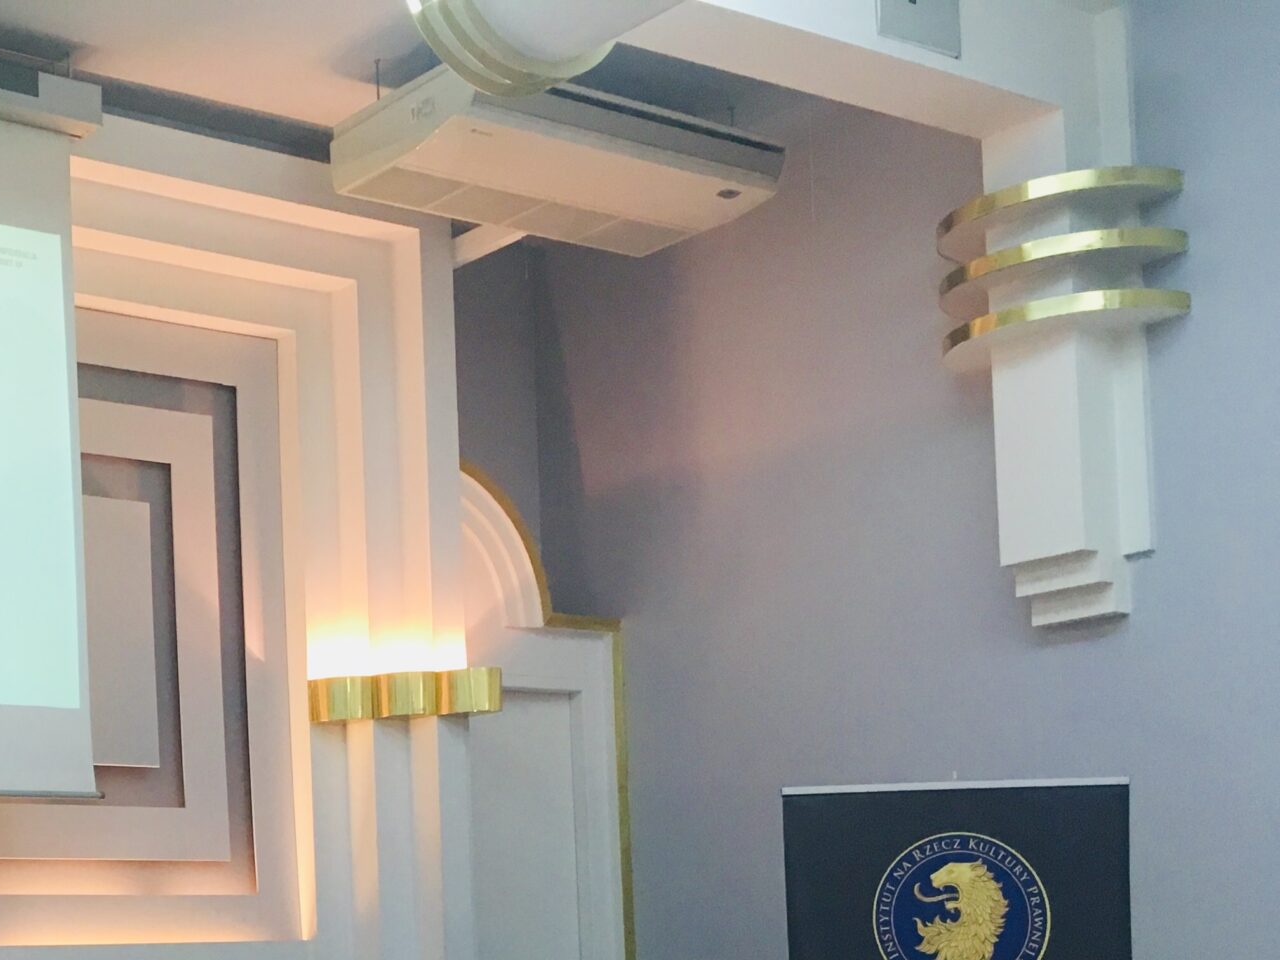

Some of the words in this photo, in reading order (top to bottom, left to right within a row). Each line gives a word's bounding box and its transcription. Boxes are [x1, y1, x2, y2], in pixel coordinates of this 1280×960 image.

[879, 883, 899, 960] INSTYTUT
[893, 861, 912, 880] NA
[912, 838, 961, 862] RZECZ
[969, 838, 1030, 882] KULTURY
[1024, 886, 1043, 957] PRAWNEJ
